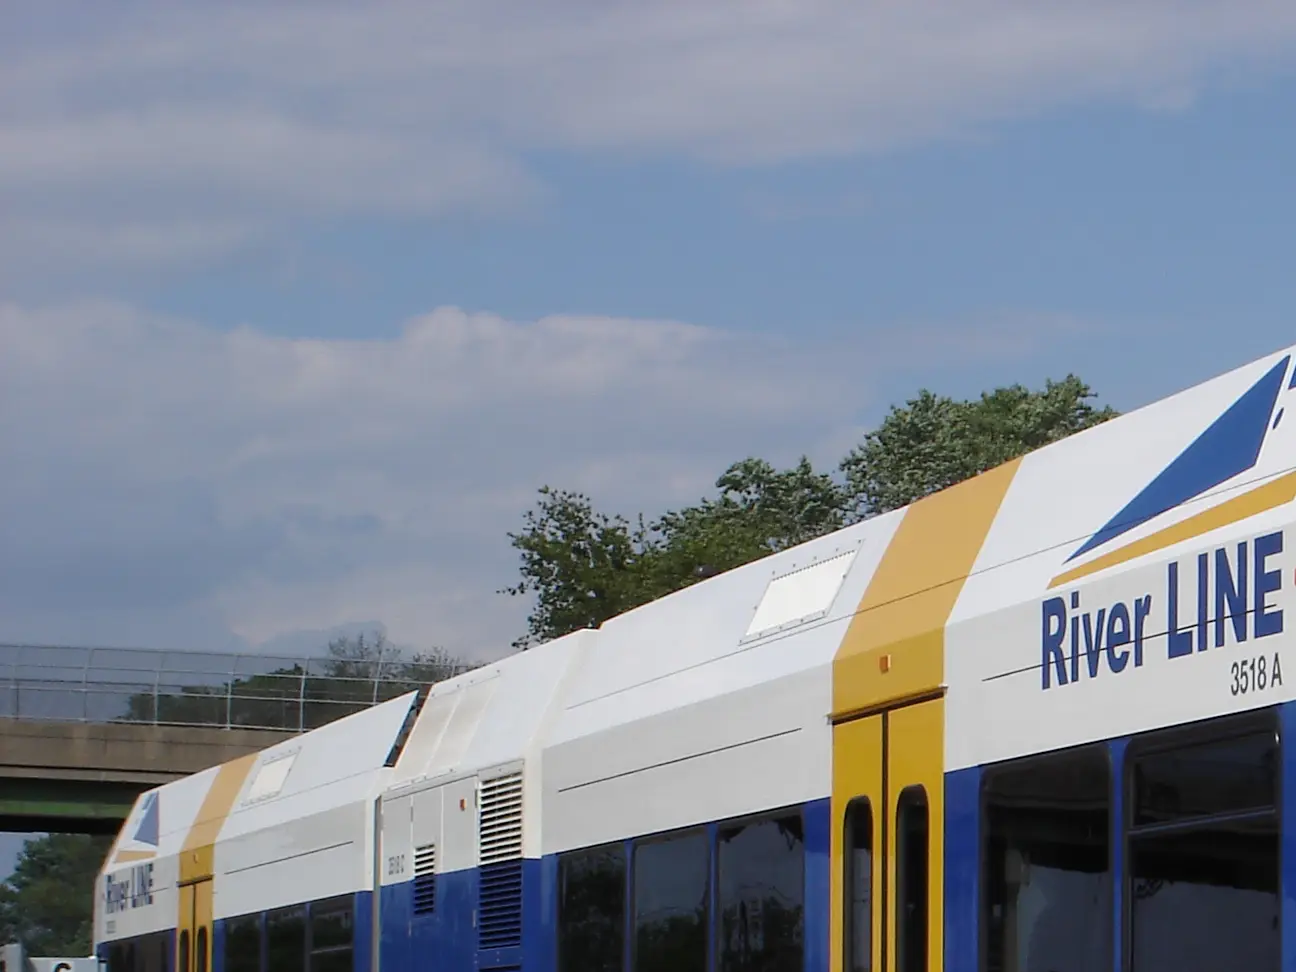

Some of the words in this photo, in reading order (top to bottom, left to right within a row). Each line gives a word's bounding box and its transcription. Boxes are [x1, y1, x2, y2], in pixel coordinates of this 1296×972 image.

[1041, 590, 1152, 691] River
[1168, 530, 1283, 660] LINE
[1230, 655, 1267, 696] 3518
[1270, 652, 1282, 688] A
